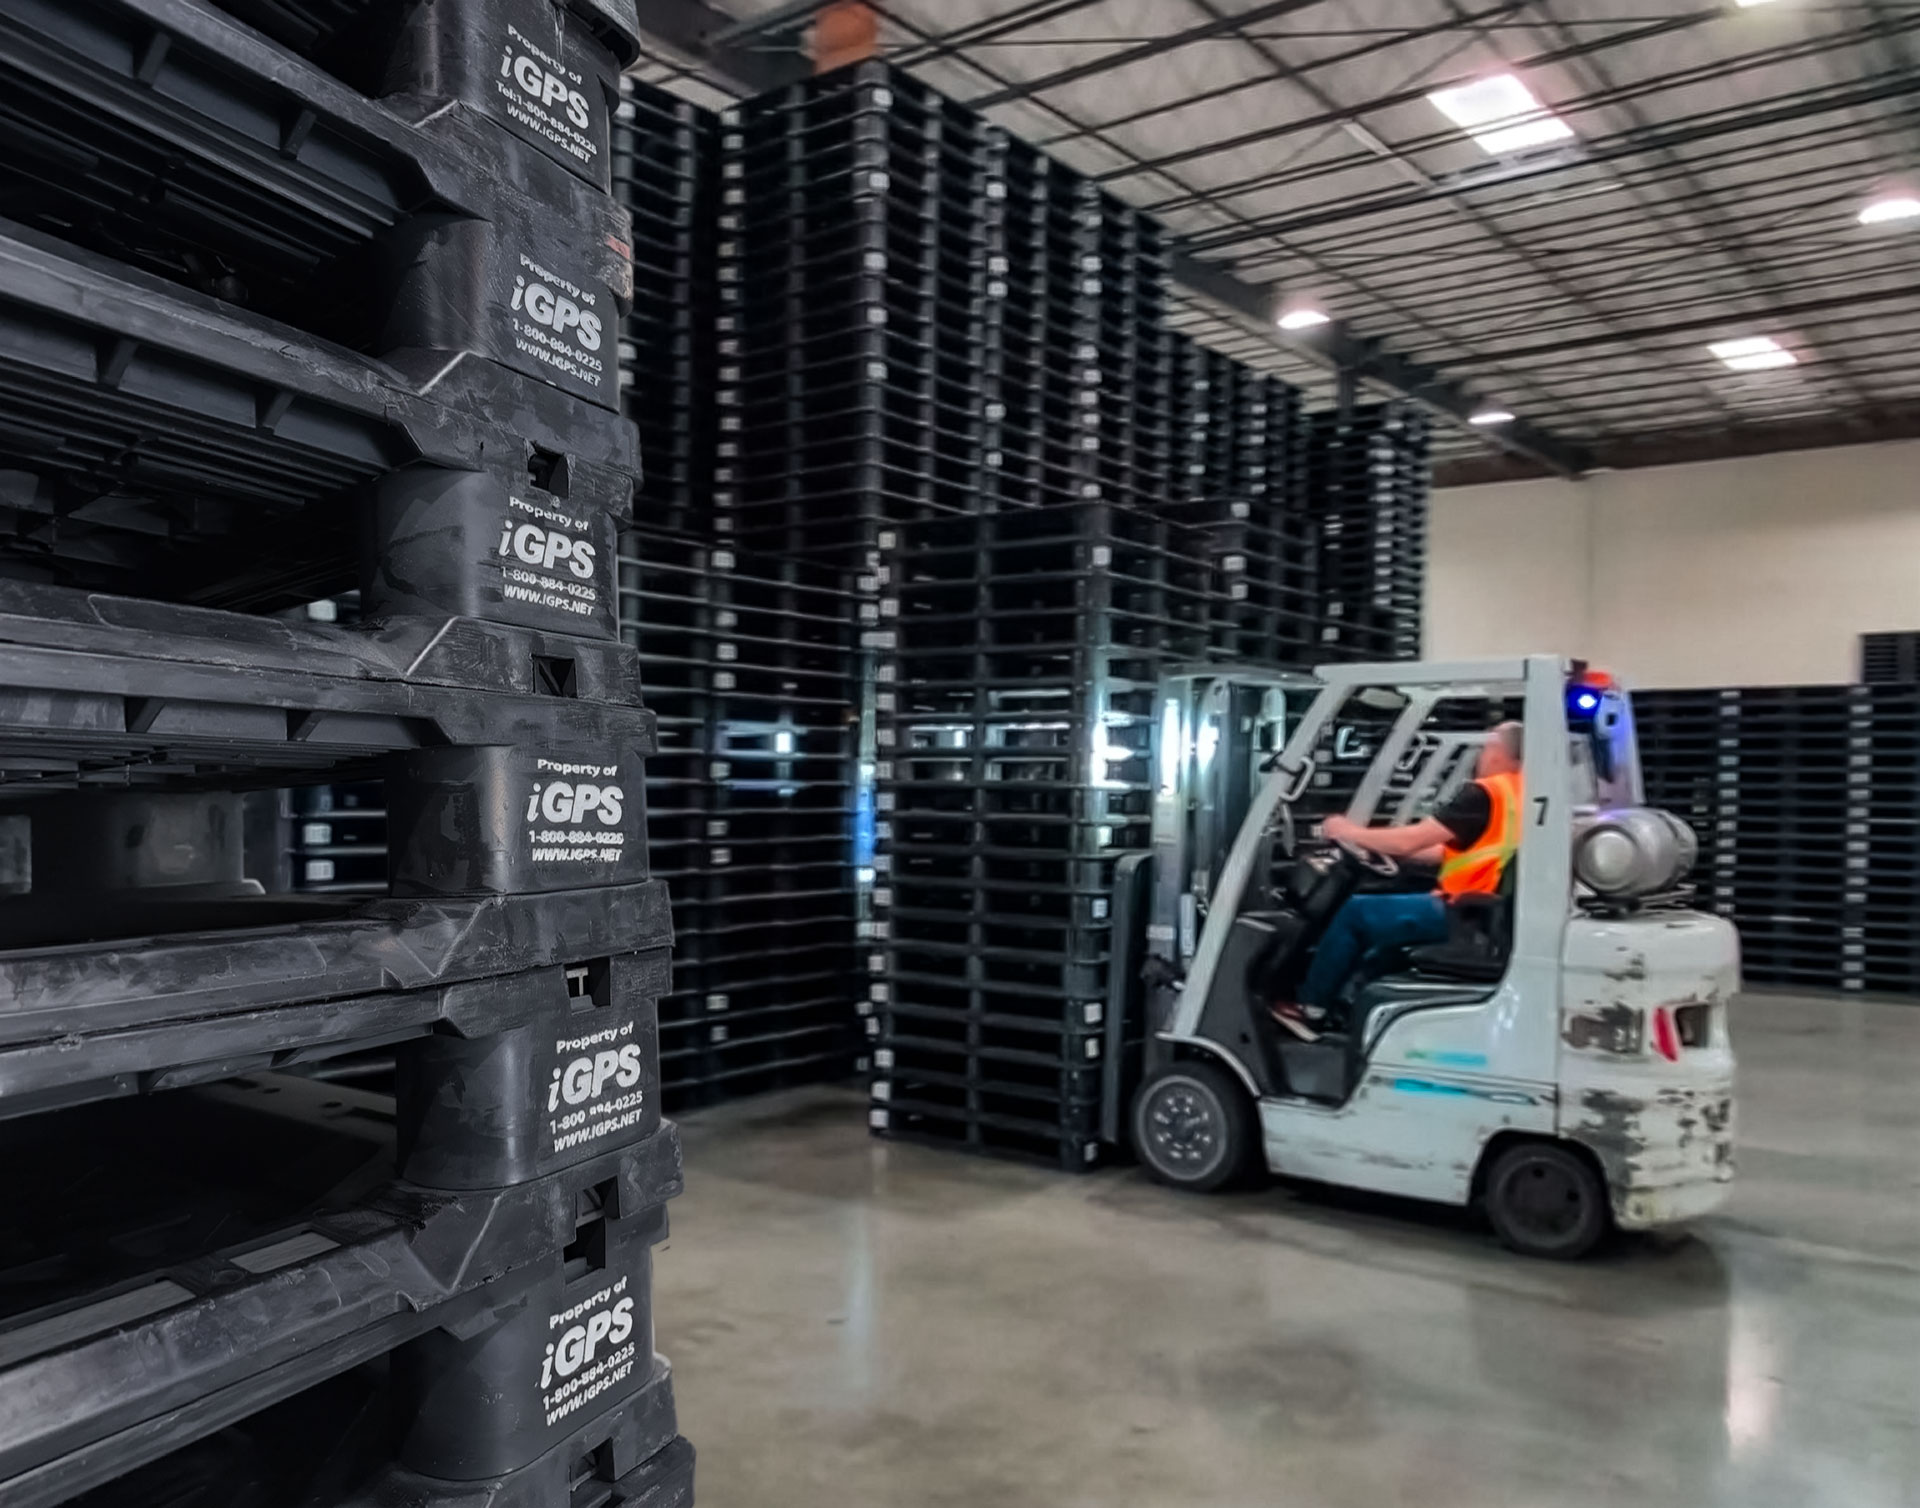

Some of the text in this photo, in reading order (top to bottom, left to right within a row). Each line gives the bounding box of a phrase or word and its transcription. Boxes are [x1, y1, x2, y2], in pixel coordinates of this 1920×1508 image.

[508, 24, 583, 85] Property of
[501, 45, 589, 129] iGPS
[520, 253, 595, 306] Property of
[511, 275, 602, 350] iGPS
[509, 496, 588, 530] Property of
[499, 520, 596, 579] iGPS
[538, 759, 617, 777] Property of
[527, 781, 624, 825] iGPS
[1533, 796, 1549, 826] 7
[556, 1021, 633, 1054] Property of
[548, 1044, 641, 1112] iGPS
[550, 1276, 627, 1329] Property of
[541, 1297, 634, 1389] iGPS
